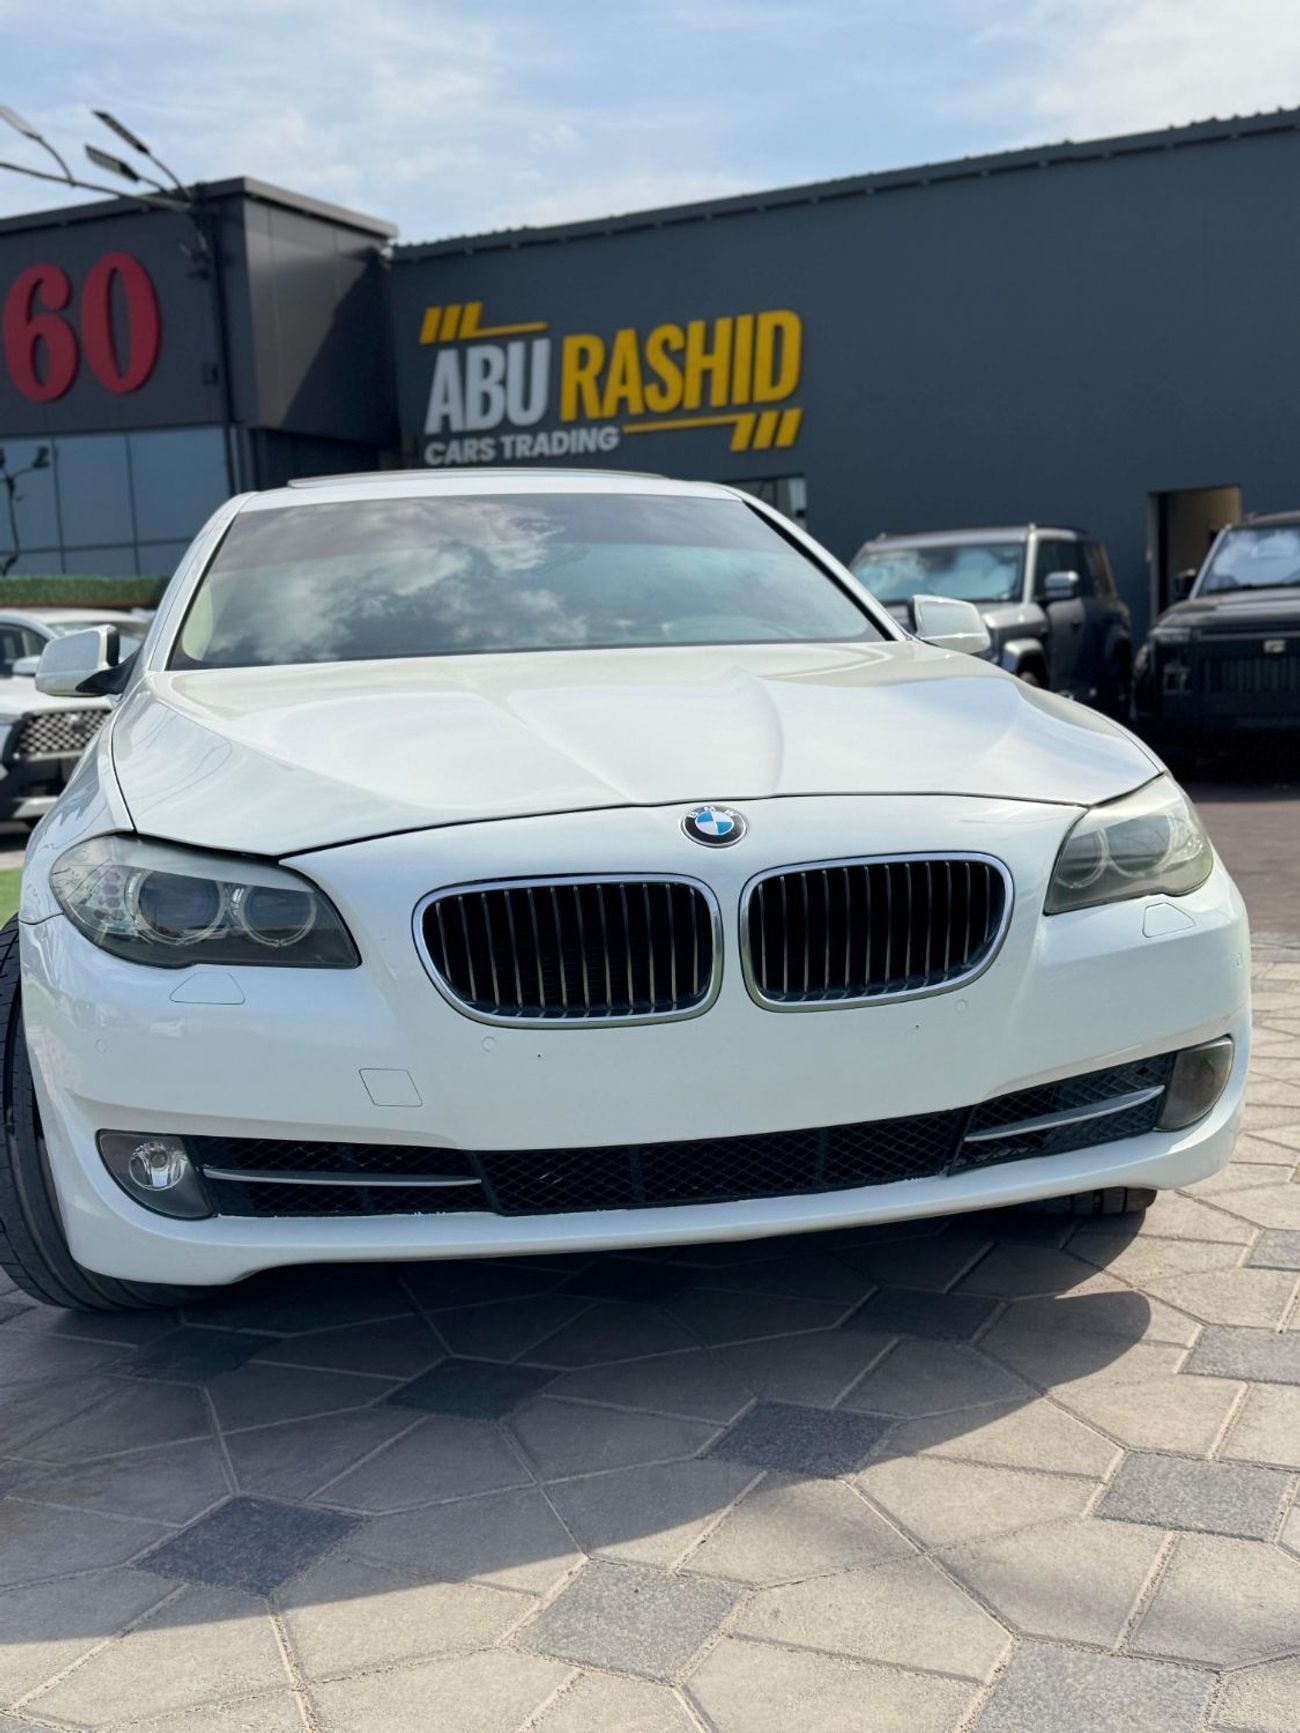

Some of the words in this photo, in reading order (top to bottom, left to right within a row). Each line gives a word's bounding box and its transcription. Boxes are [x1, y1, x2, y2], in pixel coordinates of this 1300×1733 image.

[4, 251, 160, 402] 60
[425, 338, 550, 434] ABU
[560, 309, 802, 422] RASHID
[424, 437, 496, 466] CARS
[502, 425, 620, 460] TRADING
